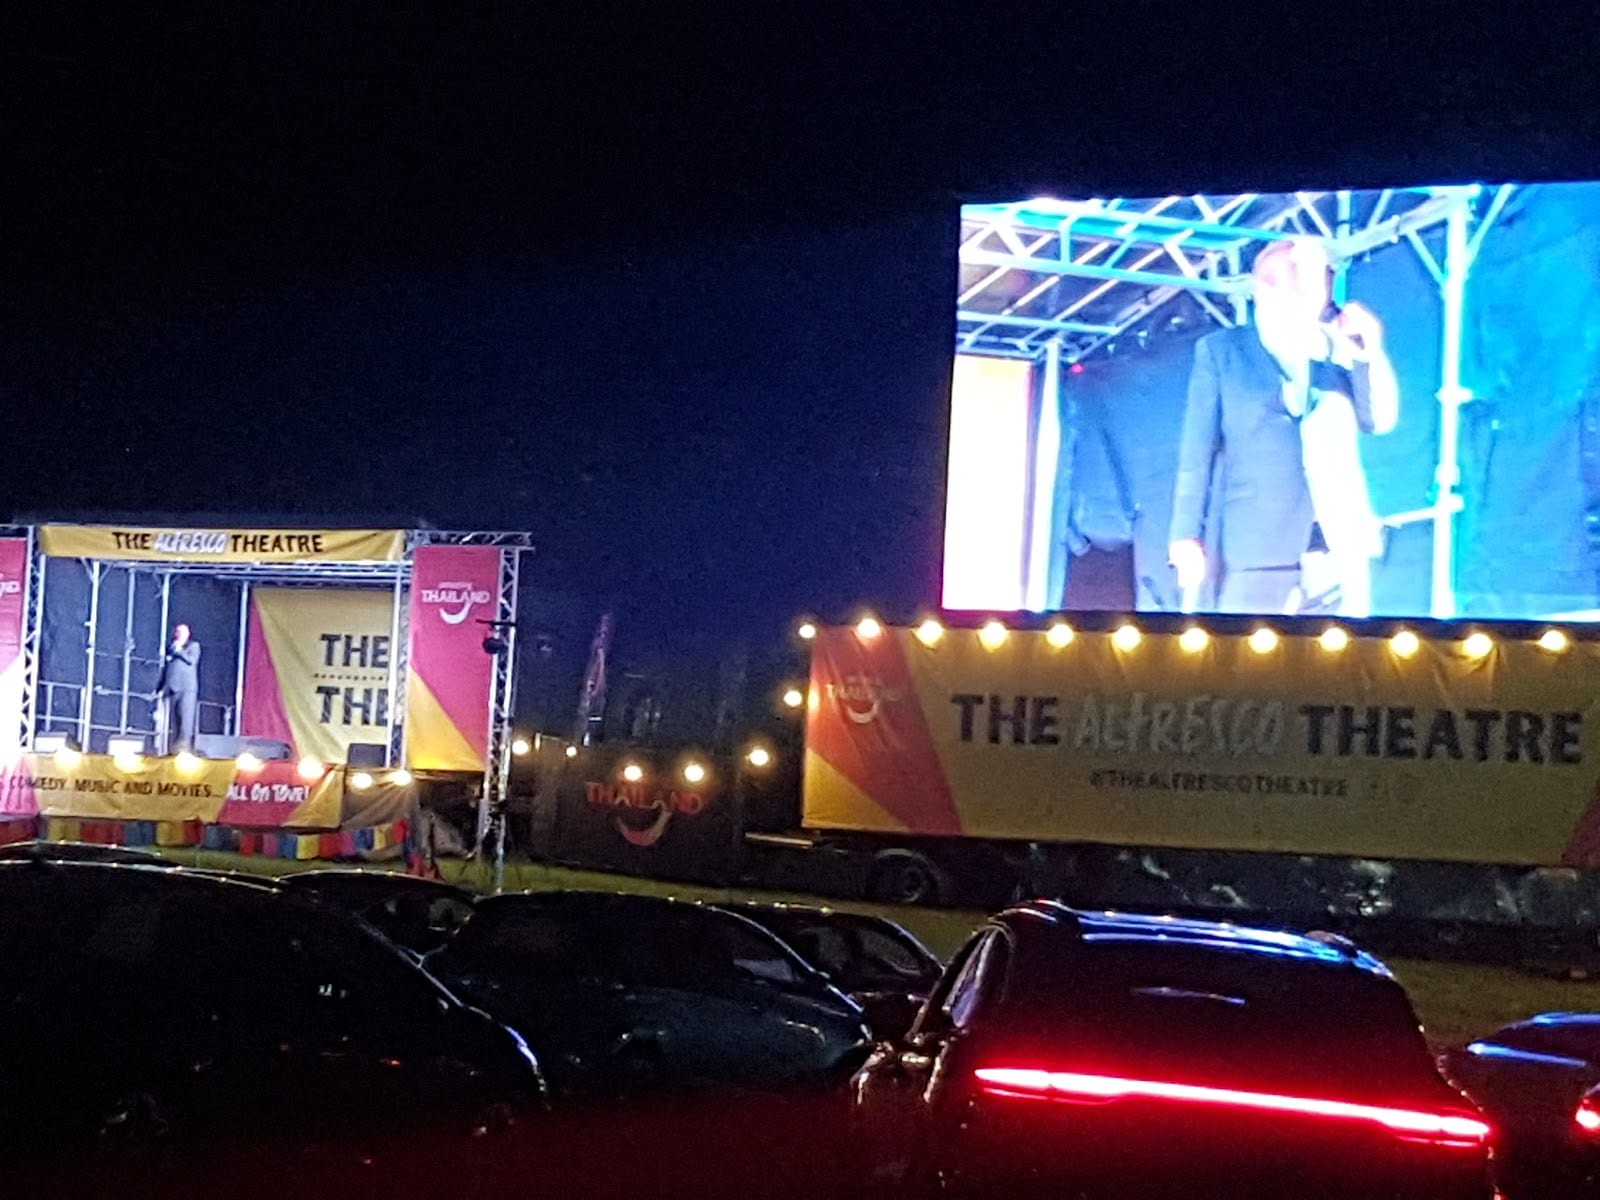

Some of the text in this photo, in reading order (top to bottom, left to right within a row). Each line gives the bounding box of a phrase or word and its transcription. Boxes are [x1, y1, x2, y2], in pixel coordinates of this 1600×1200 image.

[112, 531, 150, 550] THE
[231, 534, 323, 553] THEATRE
[421, 589, 490, 604] THAILAND
[320, 633, 389, 668] THE
[315, 686, 388, 726] THE
[951, 694, 1059, 745] THE
[1299, 705, 1582, 764] THEATRE
[74, 779, 121, 794] MUSIC
[124, 781, 153, 795] AND
